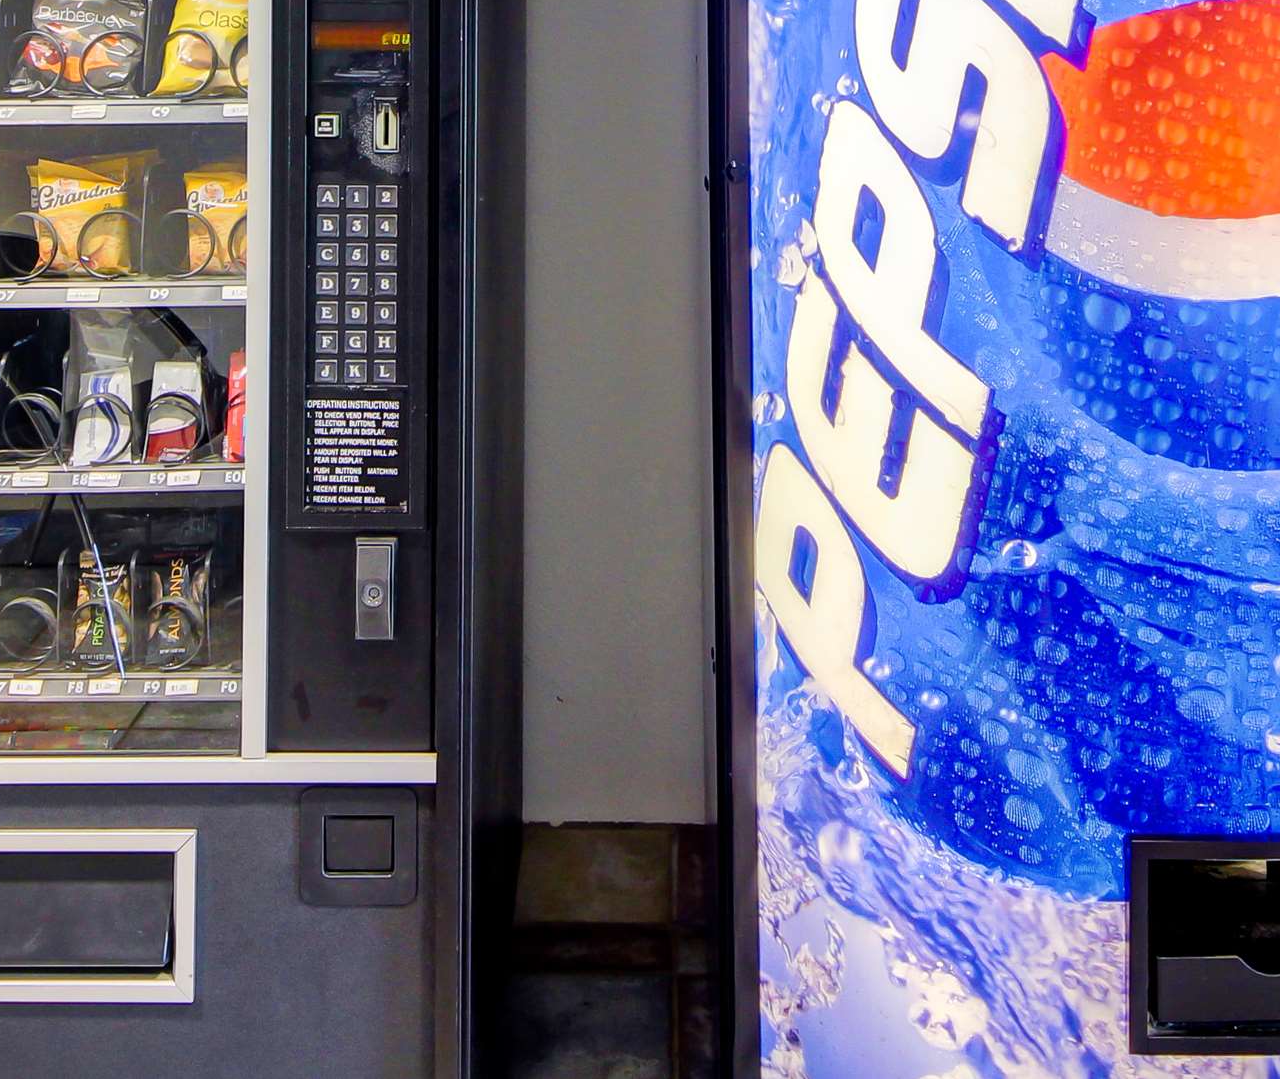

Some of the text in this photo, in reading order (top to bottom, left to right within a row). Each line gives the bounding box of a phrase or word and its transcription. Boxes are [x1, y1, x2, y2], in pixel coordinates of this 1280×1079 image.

[38, 5, 117, 29] Barbecue
[151, 106, 171, 118] C9
[322, 191, 392, 203] A 1 2
[322, 220, 390, 232] B 3 4
[321, 249, 390, 261] C 5 6
[321, 278, 390, 290] D 7 8
[150, 288, 170, 300] D9
[321, 307, 390, 319] E 9 0
[322, 336, 391, 348] F G H
[321, 365, 390, 378] J K L
[307, 400, 400, 410] OPERATING INSTRUCTIONS
[71, 474, 88, 486] E8
[148, 473, 166, 484] E9
[67, 682, 84, 694] F8
[143, 681, 161, 694] F9
[220, 681, 238, 693] F0
